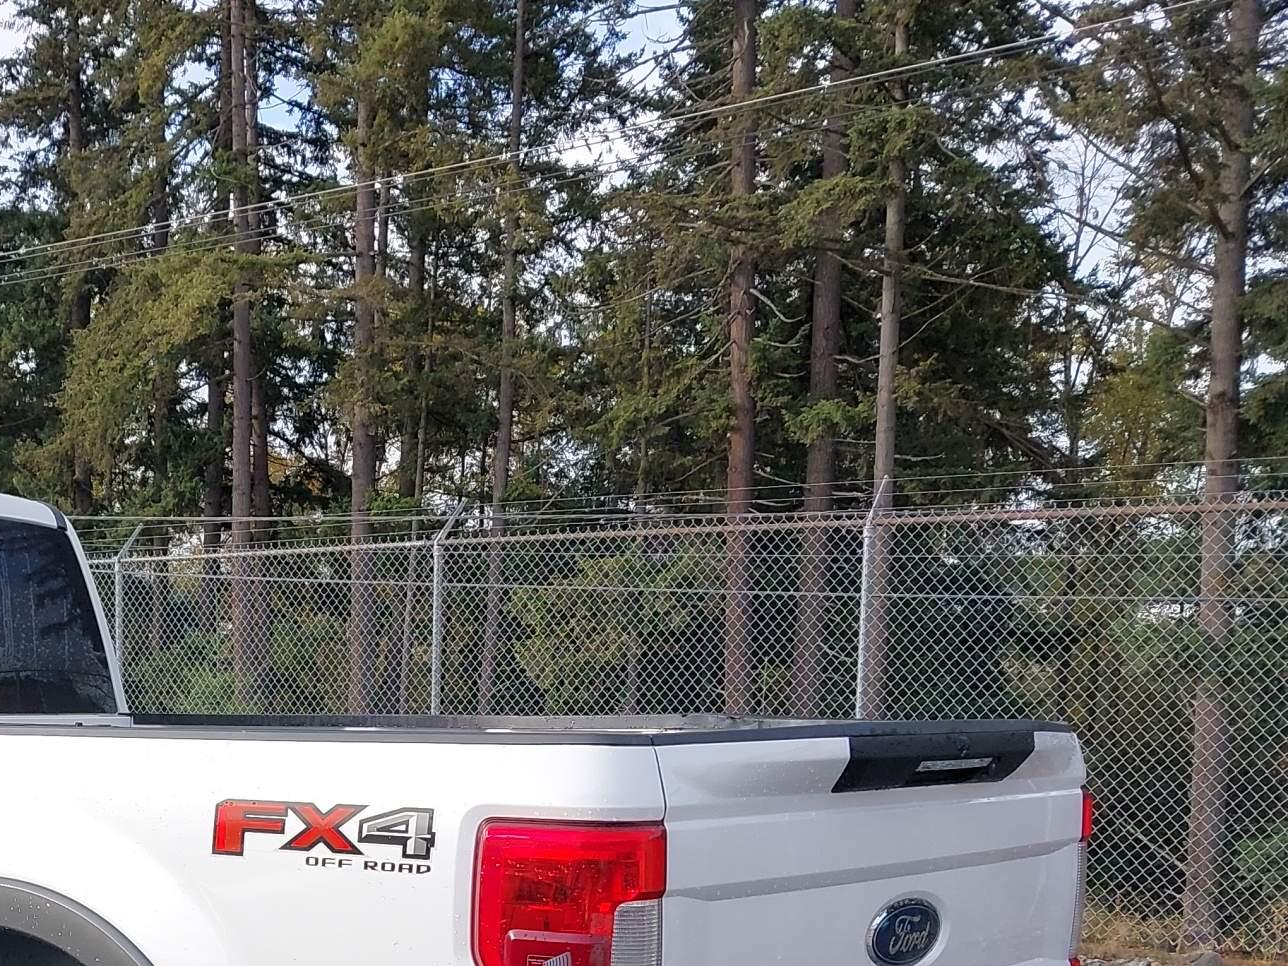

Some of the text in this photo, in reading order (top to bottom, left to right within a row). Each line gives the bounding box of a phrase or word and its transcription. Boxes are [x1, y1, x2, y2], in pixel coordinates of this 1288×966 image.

[212, 798, 435, 860] FX4
[305, 856, 432, 875] OFF ROAD
[889, 914, 931, 955] Ford
